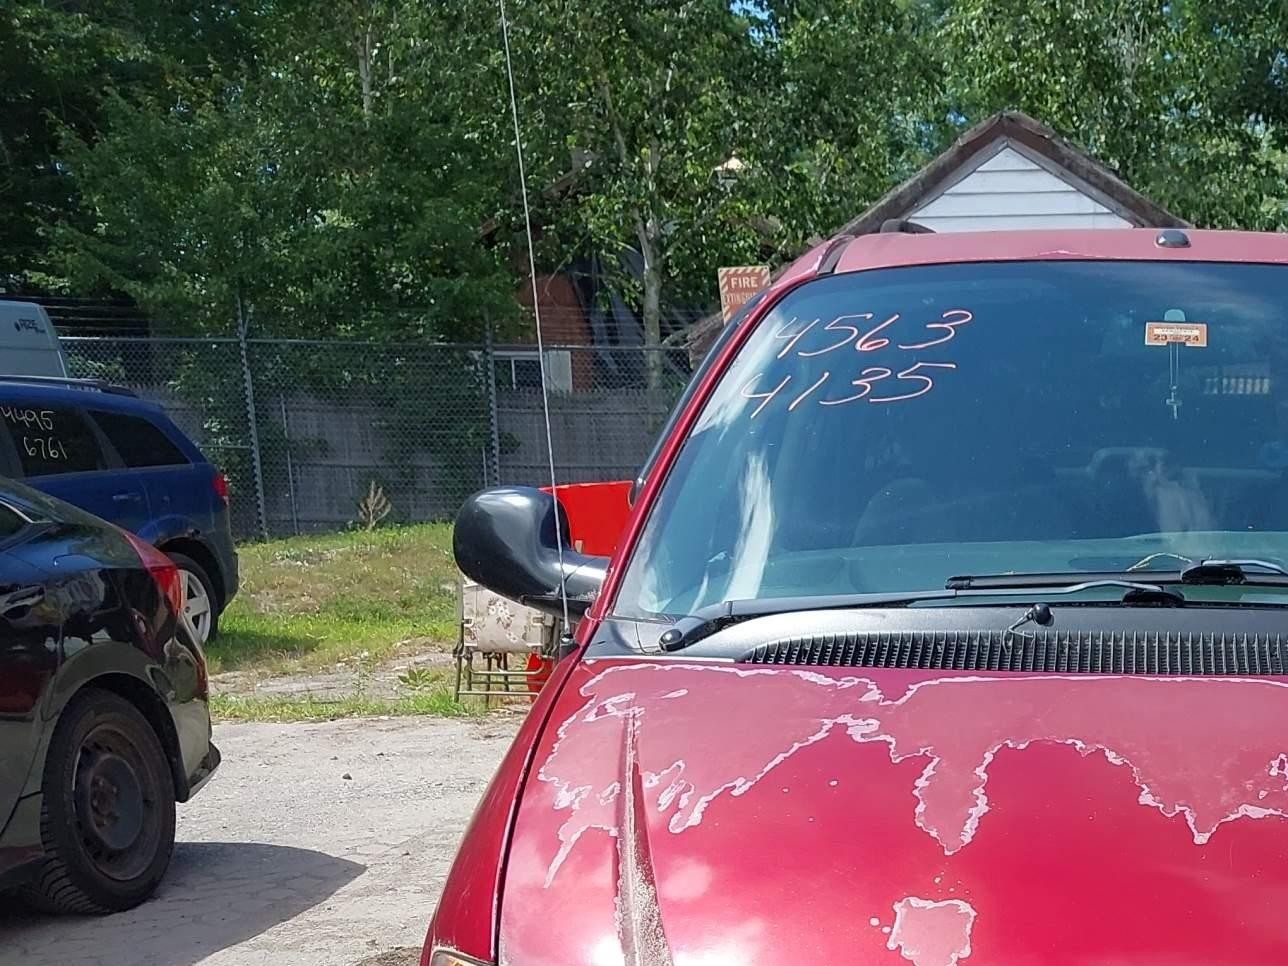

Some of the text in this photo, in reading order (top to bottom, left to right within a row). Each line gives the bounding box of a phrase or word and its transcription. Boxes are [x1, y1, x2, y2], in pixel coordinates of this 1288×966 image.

[730, 276, 758, 289] FIRE
[775, 310, 973, 359] 4563
[740, 362, 957, 419] 4135
[0, 406, 55, 431] 4495
[23, 436, 68, 460] 6761
